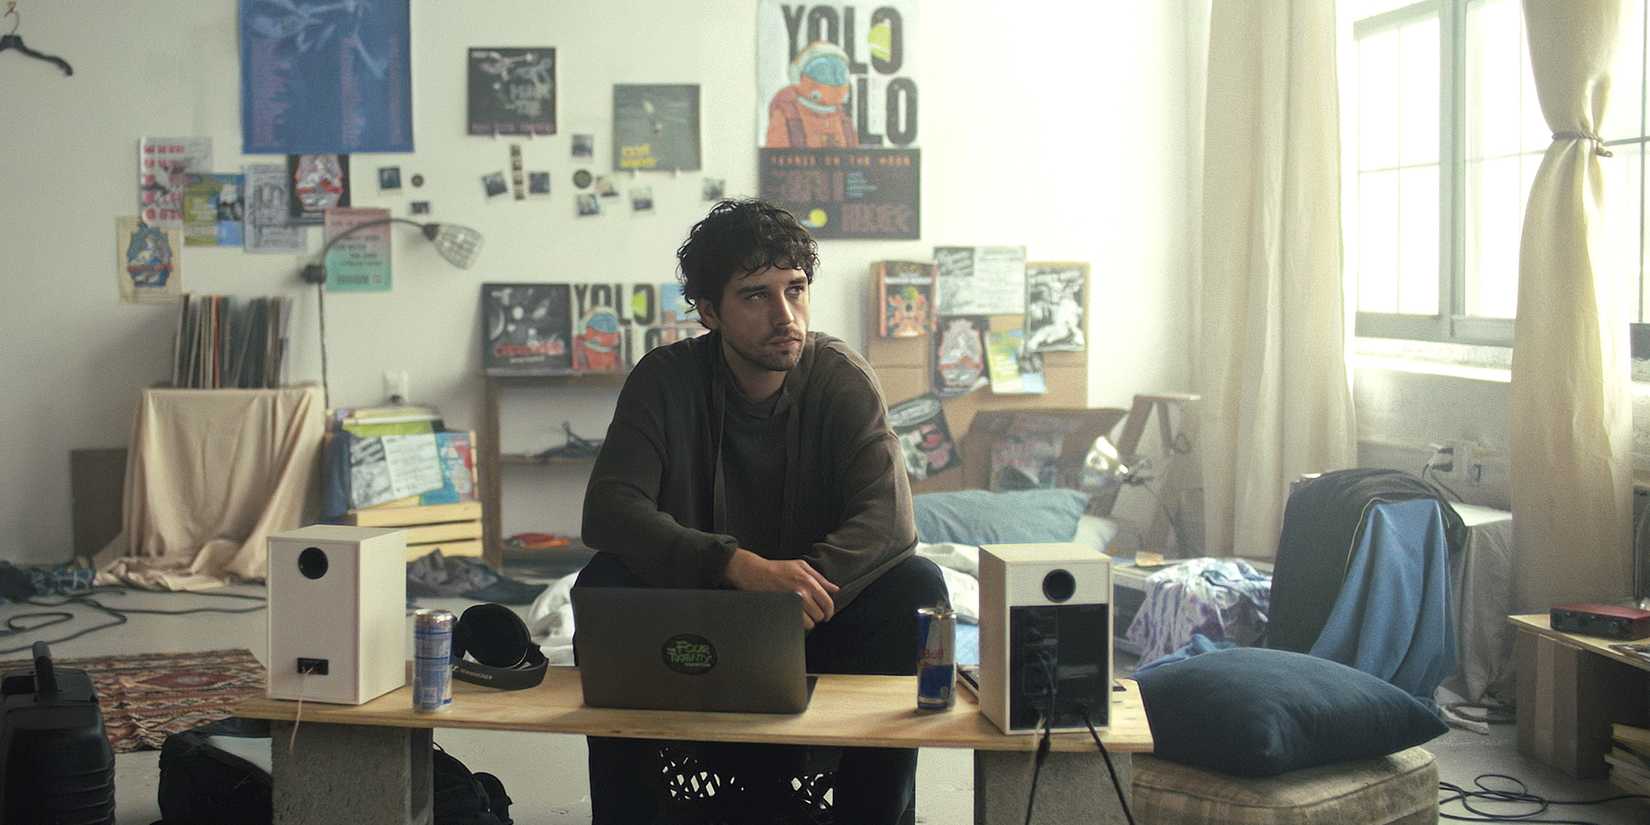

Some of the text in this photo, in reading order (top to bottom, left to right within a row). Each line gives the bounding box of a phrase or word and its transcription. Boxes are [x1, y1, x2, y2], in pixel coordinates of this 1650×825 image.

[781, 5, 903, 75] YOLO
[846, 77, 918, 146] LO
[574, 284, 655, 326] YOLO
